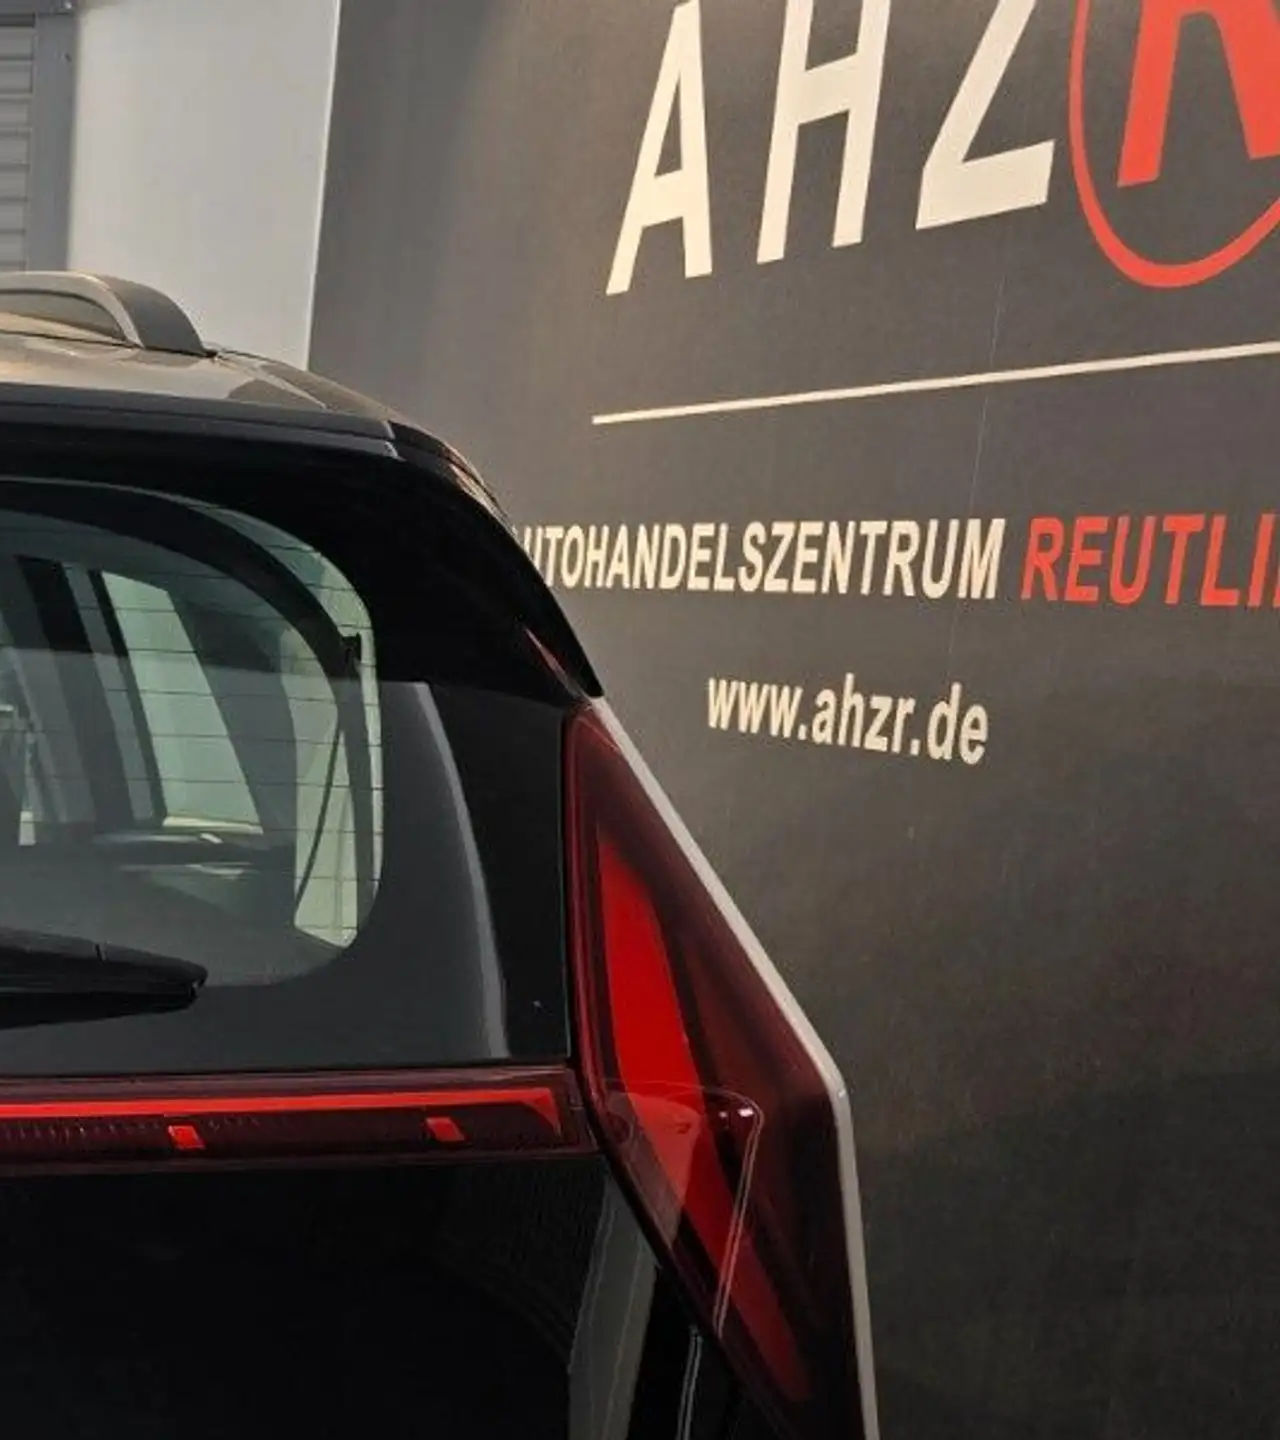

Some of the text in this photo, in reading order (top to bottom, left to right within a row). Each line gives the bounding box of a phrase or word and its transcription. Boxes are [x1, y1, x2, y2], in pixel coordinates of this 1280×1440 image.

[512, 513, 1280, 608] UTOHANDELSZENTRUM REUTLI
[707, 672, 988, 765] www.ahzr.de
